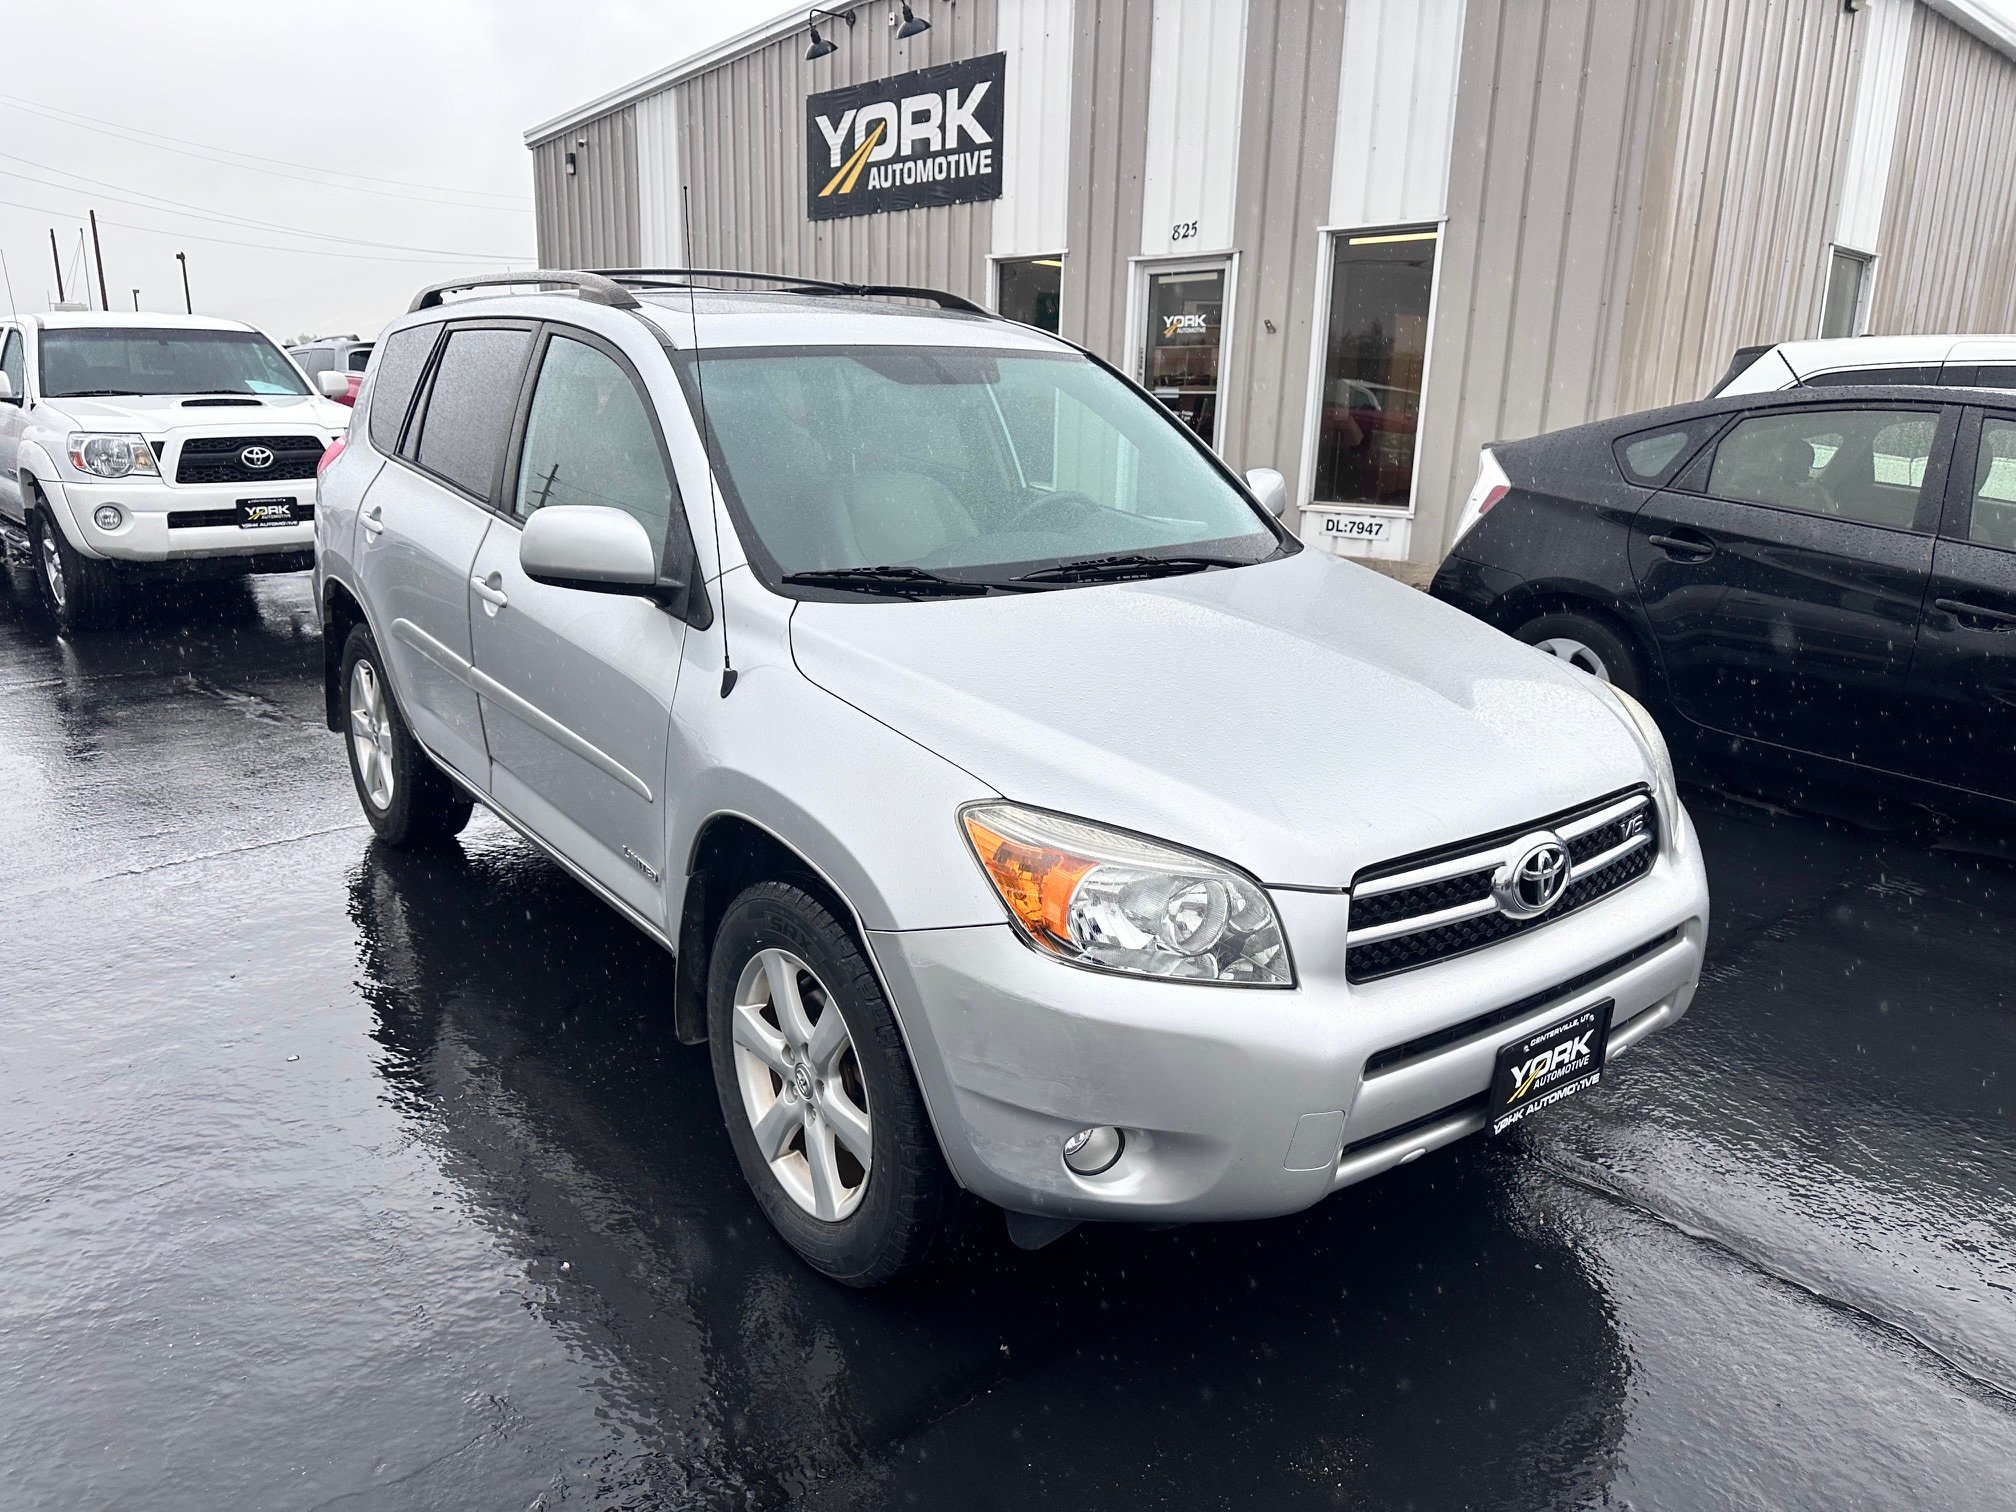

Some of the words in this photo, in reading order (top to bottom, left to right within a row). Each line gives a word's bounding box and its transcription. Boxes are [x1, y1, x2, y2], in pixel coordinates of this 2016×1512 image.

[814, 80, 993, 168] YORK
[868, 149, 992, 190] AUTOMOTIVE
[1171, 220, 1198, 241] 825
[1163, 314, 1207, 328] YORK
[244, 505, 291, 516] YORK
[1325, 518, 1383, 536] DL:7947
[1530, 1017, 1580, 1047] CENTERVILLE,
[1580, 1013, 1591, 1024] UT
[1510, 1029, 1594, 1089] YORK
[1533, 1054, 1591, 1090] AUTOMOTIVE
[1493, 1108, 1525, 1136] YORK
[1525, 1073, 1600, 1116] AUTOMOTIVE
